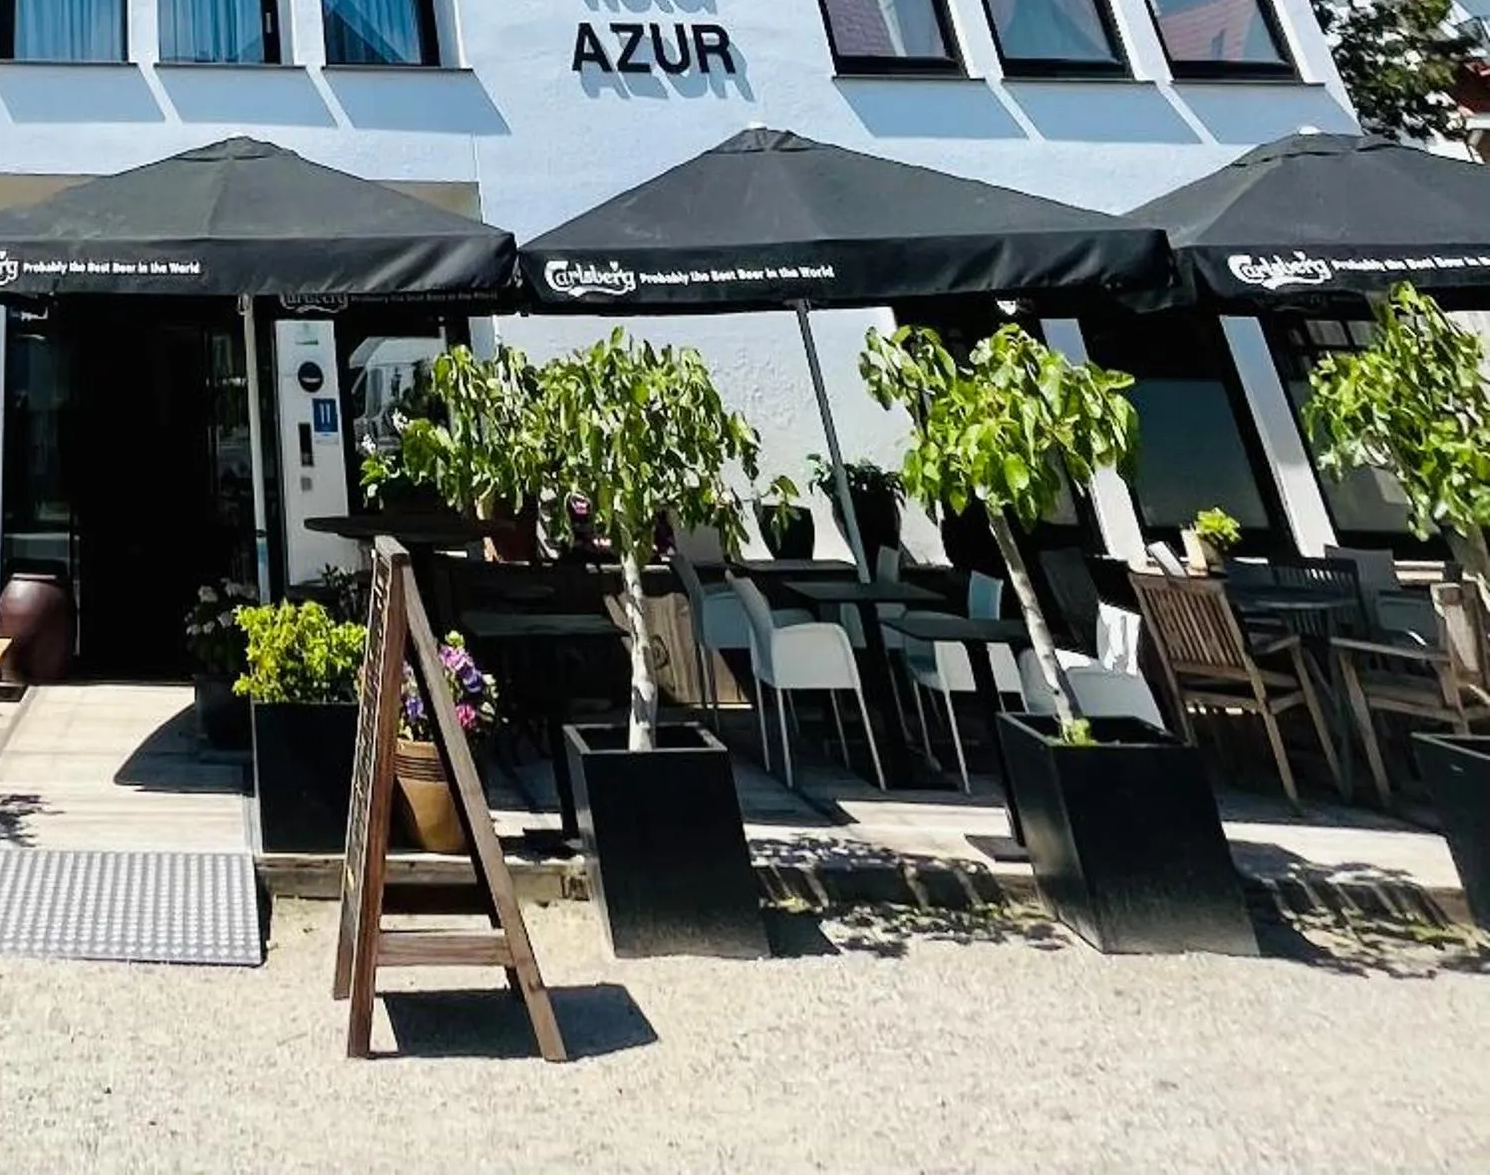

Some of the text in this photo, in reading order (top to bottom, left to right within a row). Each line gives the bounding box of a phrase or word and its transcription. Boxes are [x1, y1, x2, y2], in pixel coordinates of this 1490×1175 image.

[572, 23, 736, 74] AZUR
[23, 260, 67, 275] Probably
[69, 260, 86, 273] the
[138, 261, 148, 274] in
[150, 261, 168, 274] the
[168, 261, 200, 274] World
[544, 260, 636, 297] Carlsberg
[639, 271, 689, 286] Probably
[798, 265, 835, 278] World
[1227, 250, 1332, 290] Carlsberg
